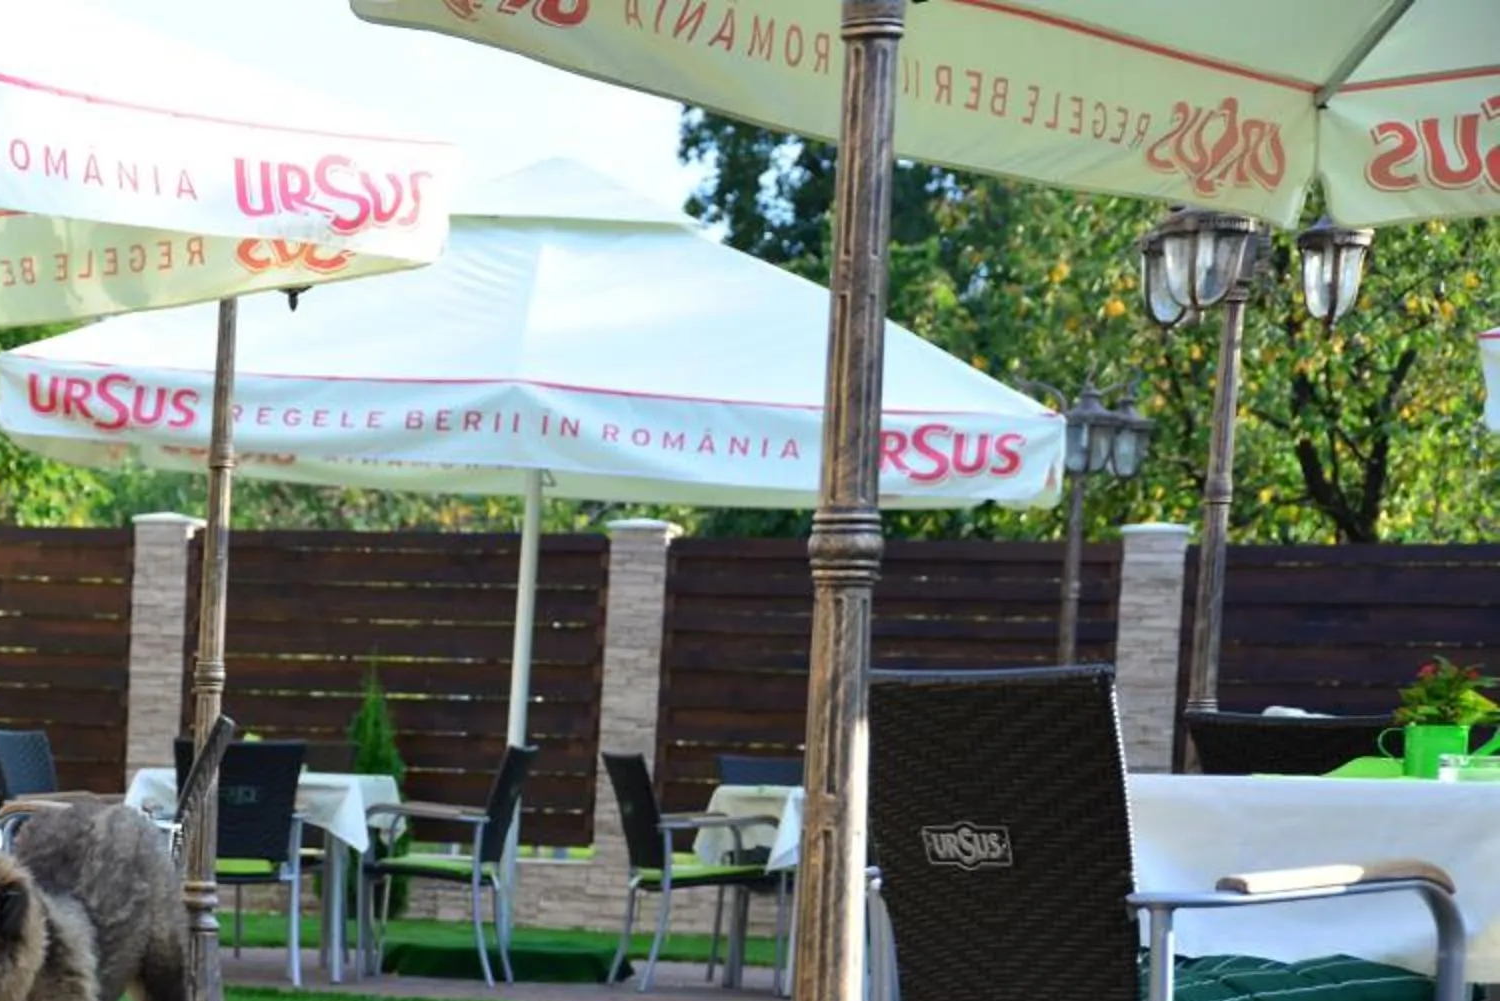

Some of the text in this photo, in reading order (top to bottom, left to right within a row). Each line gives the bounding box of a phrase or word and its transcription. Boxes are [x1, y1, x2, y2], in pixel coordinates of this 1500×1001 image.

[233, 154, 434, 236] URSUS
[27, 372, 200, 432] URSUS
[231, 406, 385, 430] REGELE
[405, 409, 519, 433] BERII
[602, 412, 800, 460] ROMÂNIA
[879, 424, 1025, 482] RSUS
[931, 827, 1002, 865] URSUS
